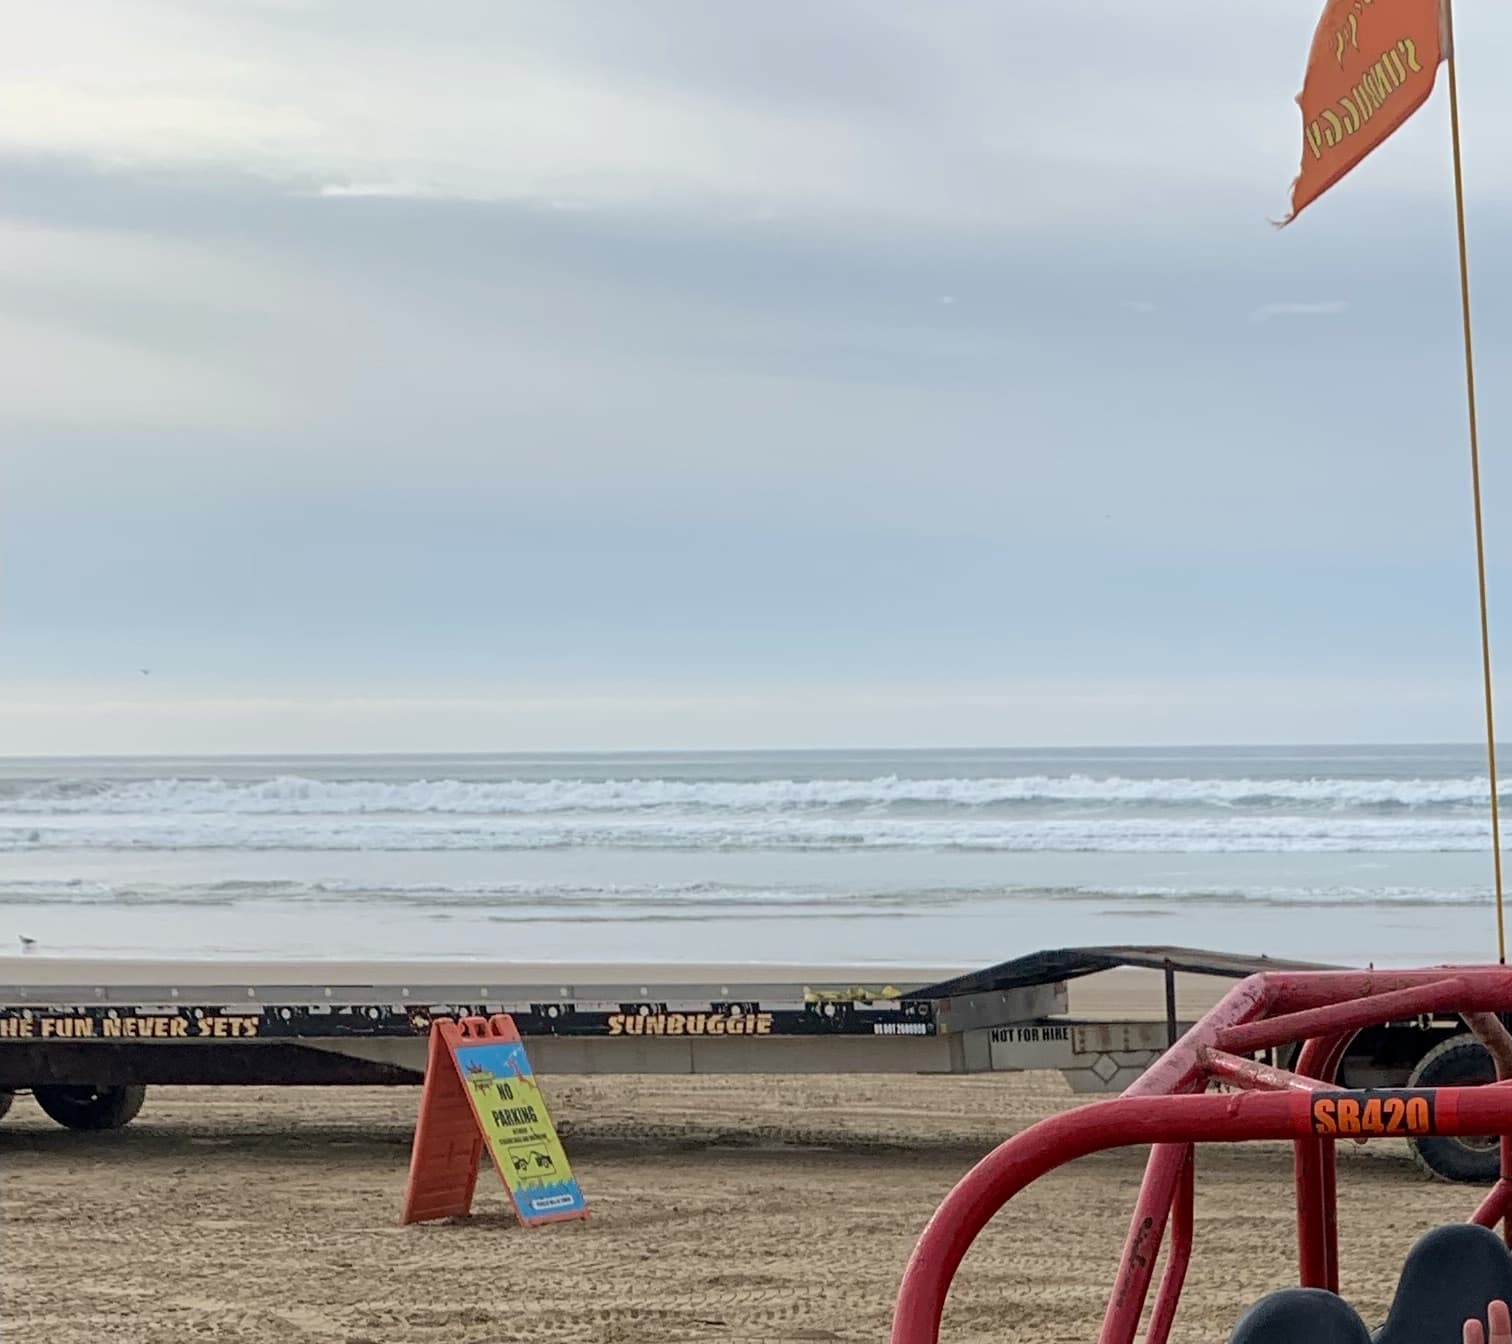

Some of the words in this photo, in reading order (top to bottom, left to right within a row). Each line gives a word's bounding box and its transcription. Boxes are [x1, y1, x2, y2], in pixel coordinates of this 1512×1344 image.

[0, 1016, 34, 1037] HE
[41, 1016, 95, 1037] FUN
[103, 1016, 189, 1037] NEVER
[197, 1016, 259, 1037] SETS
[607, 1013, 774, 1036] SUNBUGGIE
[991, 1028, 1014, 1043] NOT
[1017, 1028, 1040, 1042] FOR
[1042, 1027, 1069, 1041] HIRE
[495, 1083, 514, 1101] NO
[491, 1105, 538, 1128] PARKING
[1313, 1096, 1430, 1134] SB420
